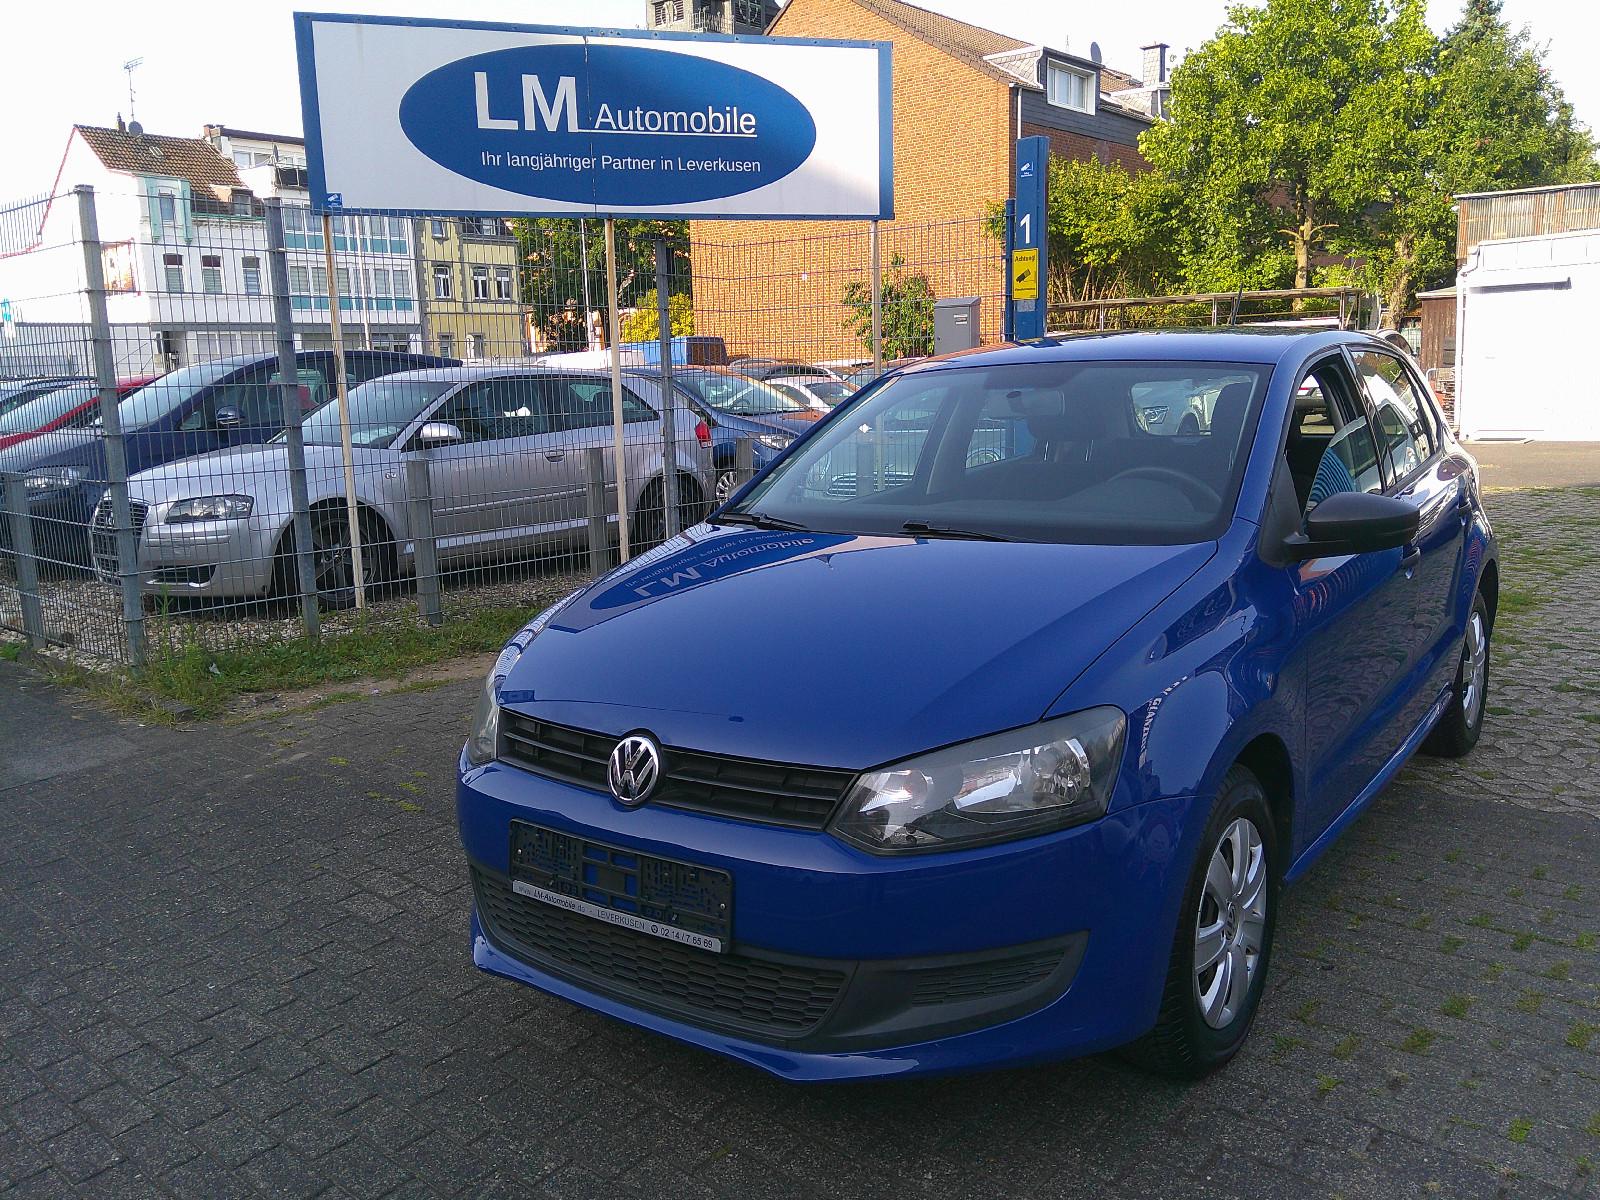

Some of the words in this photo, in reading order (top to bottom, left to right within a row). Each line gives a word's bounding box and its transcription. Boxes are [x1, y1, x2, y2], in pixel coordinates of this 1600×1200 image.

[474, 71, 579, 133] LM
[594, 103, 756, 134] Automobile
[481, 151, 502, 166] Ihr
[506, 151, 597, 172] langjähriger
[601, 154, 658, 170] Partner
[660, 155, 673, 170] in
[678, 156, 761, 172] Leverkusen
[1019, 213, 1031, 244] 1
[596, 909, 646, 930] LEVERKUSEN
